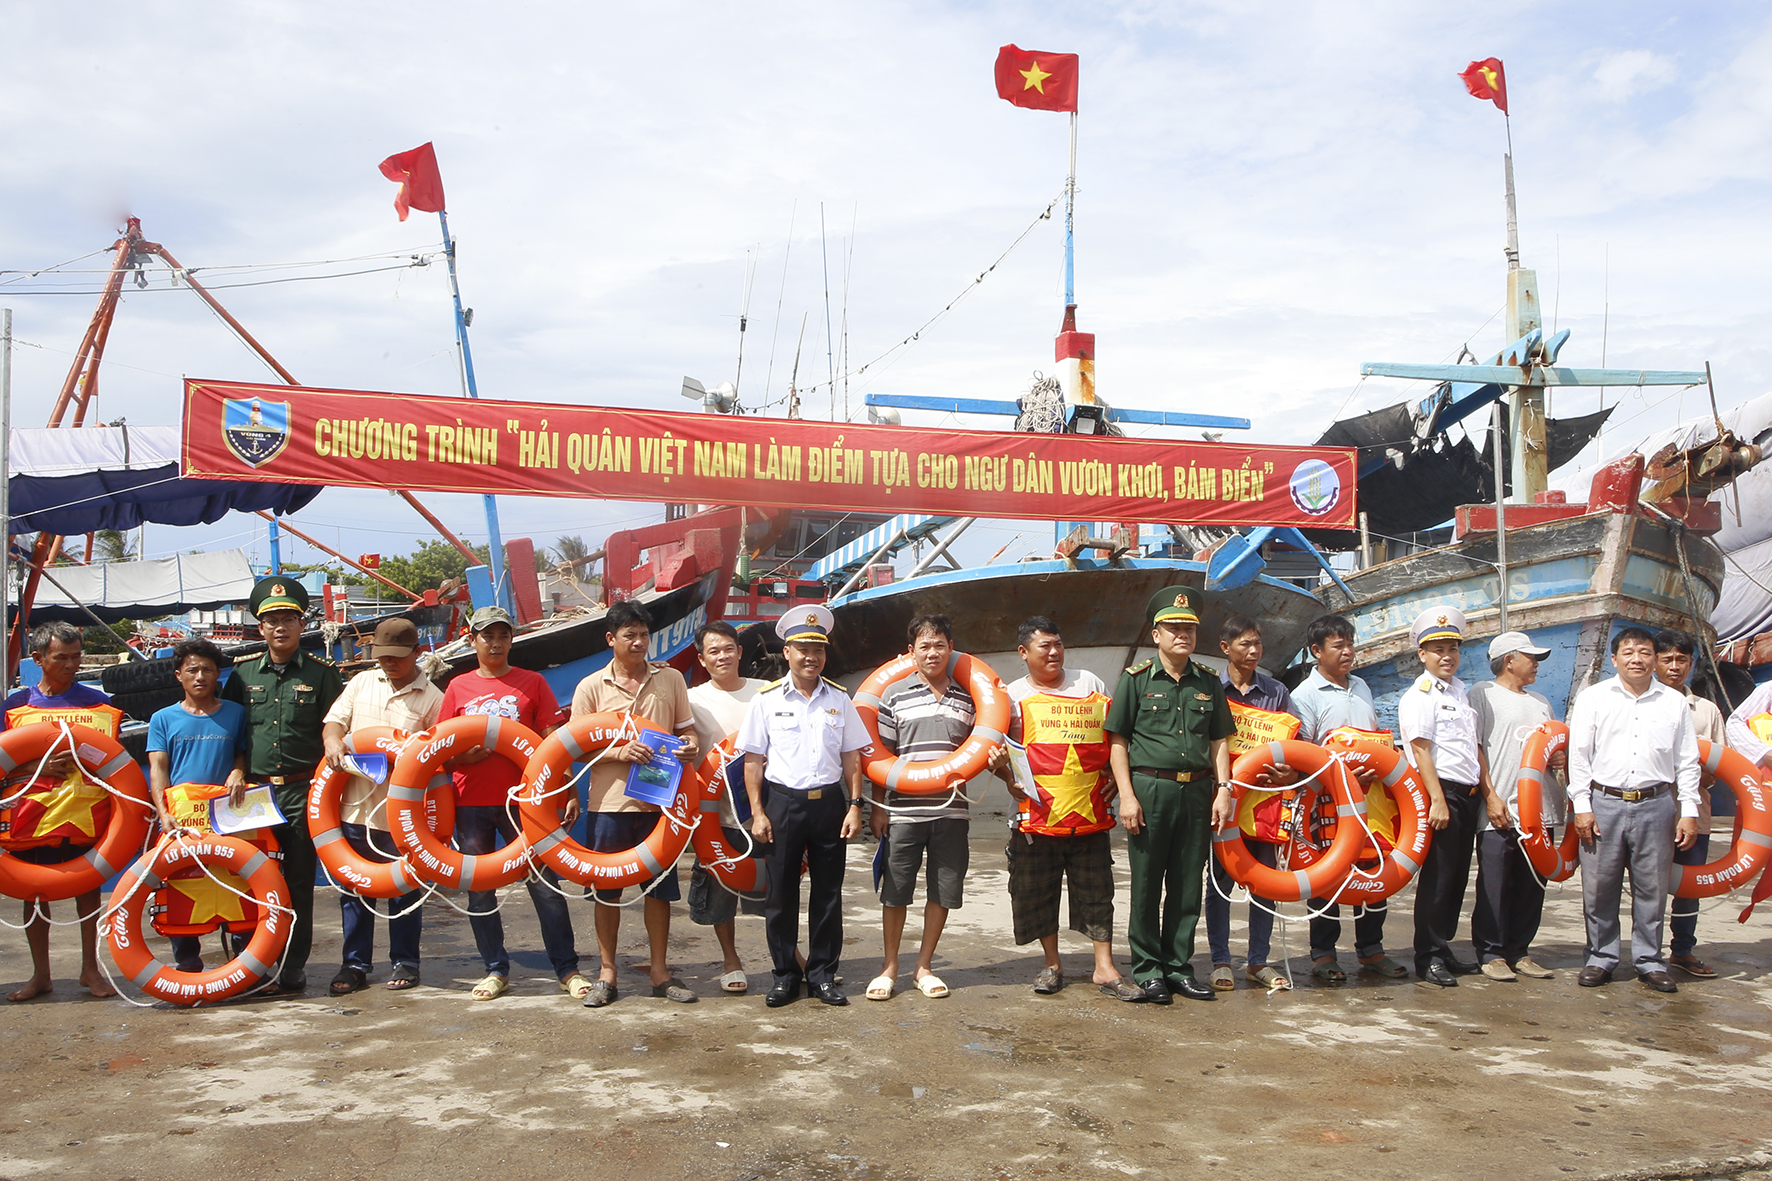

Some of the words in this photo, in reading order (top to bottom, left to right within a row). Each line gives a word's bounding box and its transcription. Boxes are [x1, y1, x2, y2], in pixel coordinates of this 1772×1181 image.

[315, 417, 418, 461] CHƯƠNG
[425, 418, 498, 465] TRÌNH
[566, 427, 631, 475] QUÂN
[639, 431, 688, 483] VIỆT
[694, 440, 747, 478] NAM
[754, 437, 801, 481] LÀM
[808, 434, 863, 484] ĐIỂM
[870, 448, 911, 494] TỰA
[917, 452, 959, 489] CHO
[964, 454, 1009, 492] NGƯ
[1013, 452, 1054, 494] DÂN
[1059, 458, 1112, 496] VƯƠN
[1117, 461, 1168, 503] KHƠI,
[1174, 460, 1216, 501] BÁM
[1051, 704, 1062, 716] BỘ
[1040, 718, 1061, 728] VÙNG
[1063, 720, 1068, 728] 4
[1070, 717, 1083, 728] HẢI
[1084, 718, 1101, 729] QUÂN
[321, 765, 334, 779] 95
[707, 780, 720, 794] BTL
[1403, 777, 1417, 792] BTL
[193, 802, 205, 814] BỘ
[427, 800, 437, 814] BTL
[398, 809, 415, 832] QUÂN
[670, 793, 689, 836] Tặg
[403, 831, 420, 847] HẢI
[214, 845, 236, 859] 955
[414, 844, 423, 853] 4
[418, 849, 440, 870] VÙNG
[557, 847, 579, 869] QUÂN
[439, 862, 455, 877] BTL
[577, 861, 593, 875] HẢI
[593, 865, 600, 876] 4
[599, 866, 624, 880] VÙNG
[623, 861, 640, 875] BTL
[1696, 873, 1715, 885] 955
[228, 969, 246, 984] BTL
[154, 977, 180, 994] QUÂN
[180, 984, 197, 998] HẢI
[197, 984, 204, 995] 4
[205, 980, 231, 994] VÙNG
